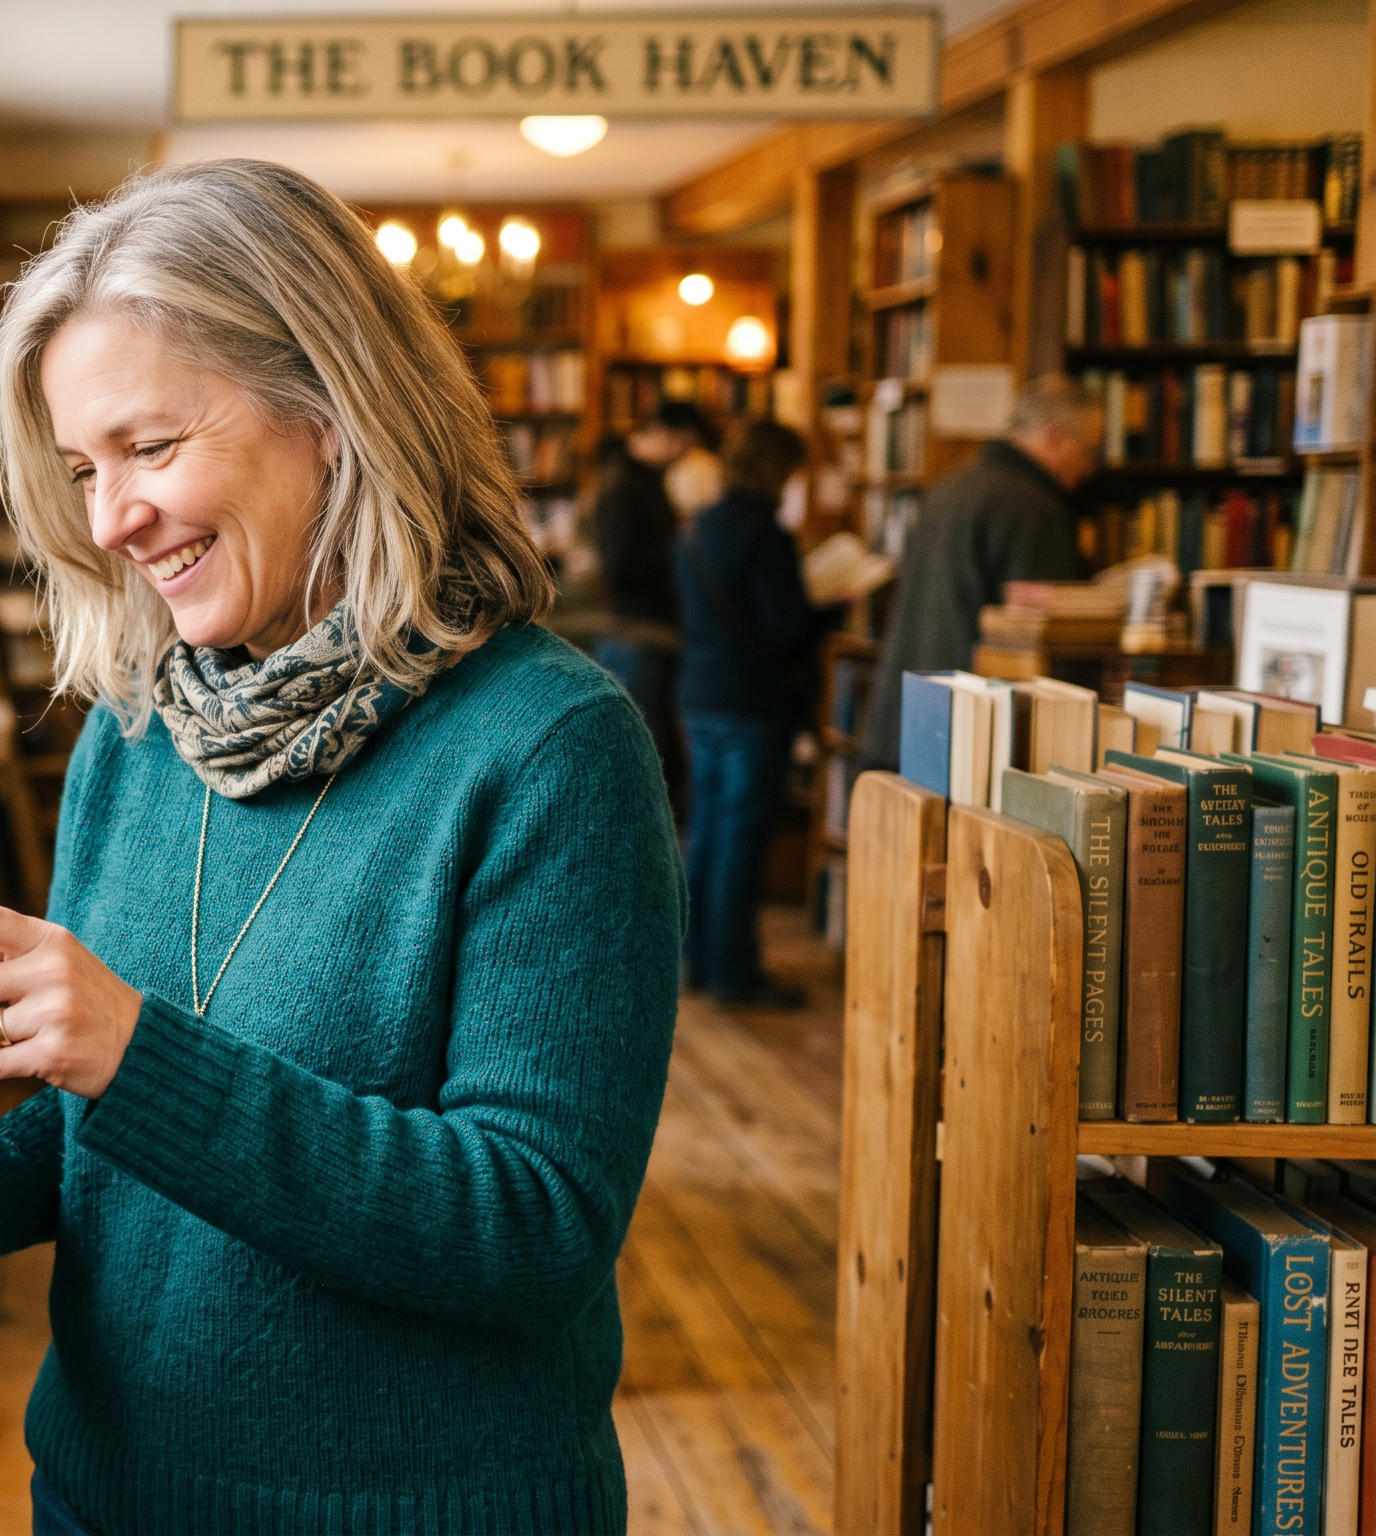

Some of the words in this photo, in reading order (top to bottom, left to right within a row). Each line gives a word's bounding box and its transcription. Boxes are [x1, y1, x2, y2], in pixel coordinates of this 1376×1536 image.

[212, 37, 369, 99] THE
[397, 35, 608, 98] BOOK
[644, 31, 897, 96] HAVEN
[1203, 814, 1243, 826] TALES
[1213, 784, 1238, 796] THE
[1089, 817, 1111, 867] THE
[1300, 788, 1330, 918] ANTIQUE
[1350, 851, 1369, 900] OLD
[1087, 876, 1110, 963] SILENT
[1347, 904, 1368, 1000] TRAILS
[1085, 970, 1106, 1043] PAGES
[1301, 931, 1326, 1018] TALES
[1158, 1288, 1217, 1303] SILENT
[1160, 1307, 1213, 1322] TALES
[1283, 1255, 1315, 1332] LOST
[1275, 1341, 1311, 1531] ADVENTURES
[1340, 1385, 1357, 1449] TALES
